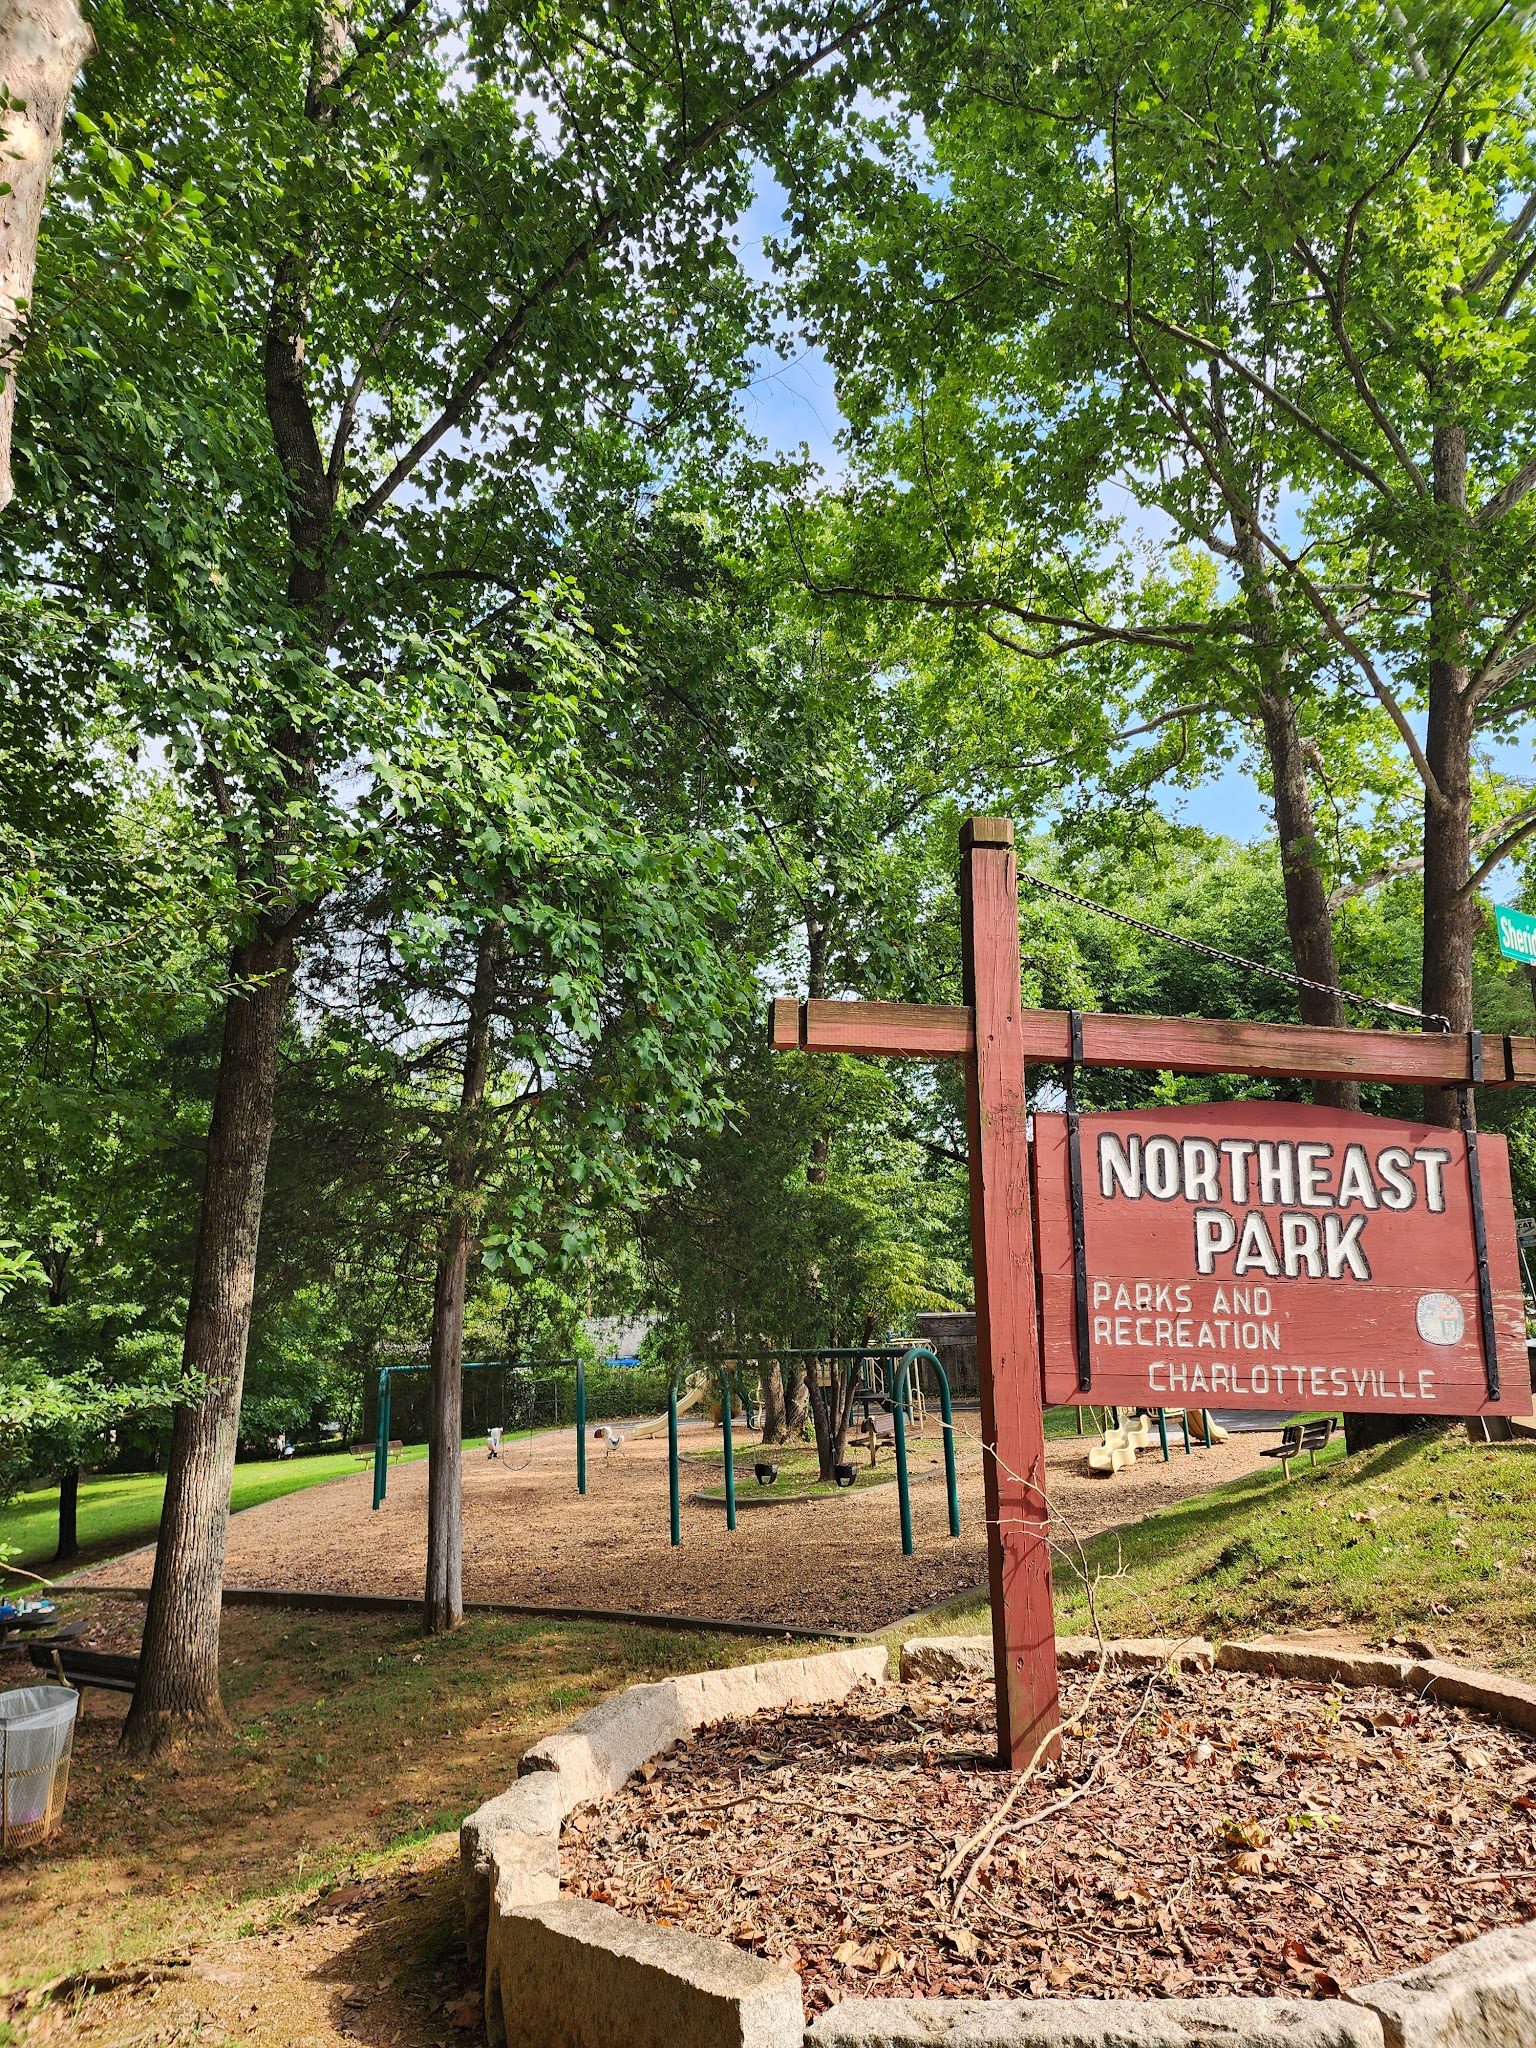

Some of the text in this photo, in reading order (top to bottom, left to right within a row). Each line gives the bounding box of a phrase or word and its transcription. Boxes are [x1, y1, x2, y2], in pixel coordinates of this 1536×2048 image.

[1098, 1132, 1452, 1213] NORTHEAST
[1194, 1207, 1373, 1281] PARK
[1093, 1281, 1272, 1316] PARKS AND
[1094, 1316, 1281, 1350] RECREATION
[1148, 1360, 1437, 1400] CHARLOTTESVILLE
